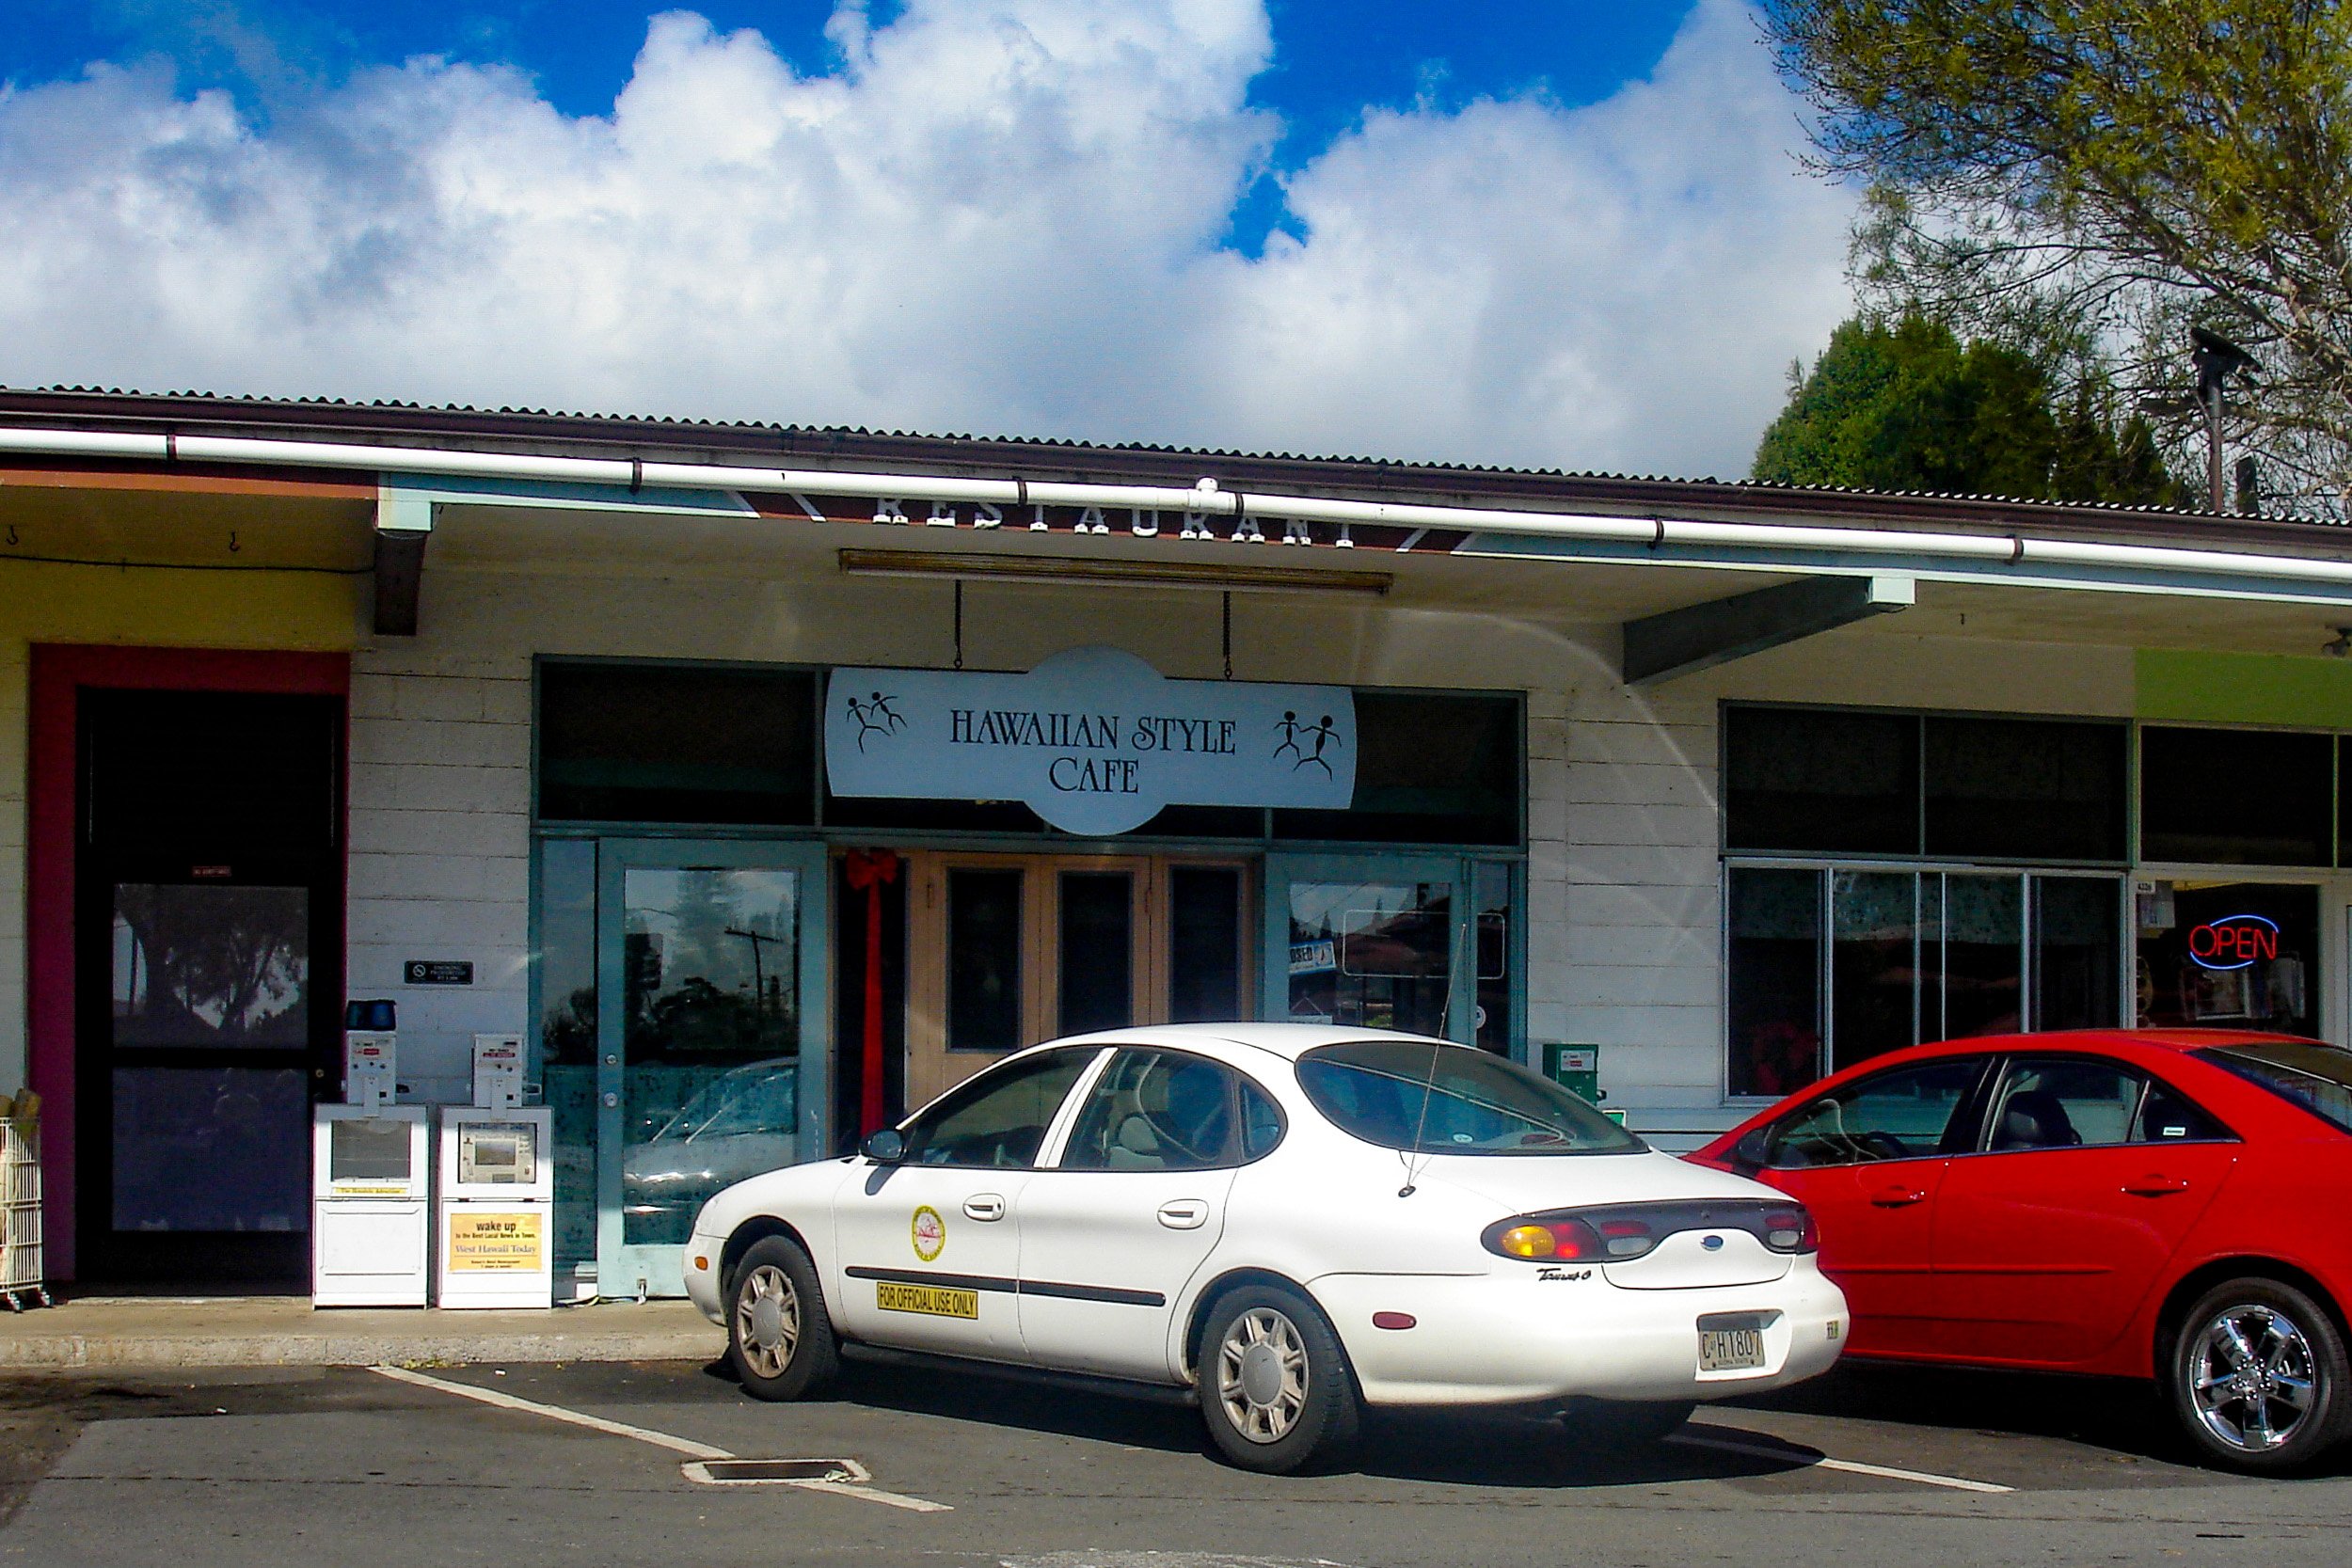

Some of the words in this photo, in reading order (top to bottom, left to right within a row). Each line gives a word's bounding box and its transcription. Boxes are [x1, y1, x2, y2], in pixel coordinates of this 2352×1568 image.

[950, 709, 1120, 750] HAWAIIAN
[1131, 716, 1236, 755] STYLE
[1049, 757, 1139, 794] CAFE
[2188, 925, 2277, 960] OPEN
[476, 1221, 501, 1231] wake
[504, 1223, 516, 1233] up
[455, 1244, 476, 1253] West
[478, 1244, 509, 1253] Hawaii
[511, 1244, 535, 1255] Today
[880, 1286, 896, 1307] FOR
[897, 1288, 932, 1310] OFFICIAL
[934, 1291, 950, 1313] USE
[953, 1292, 975, 1315] ONLY
